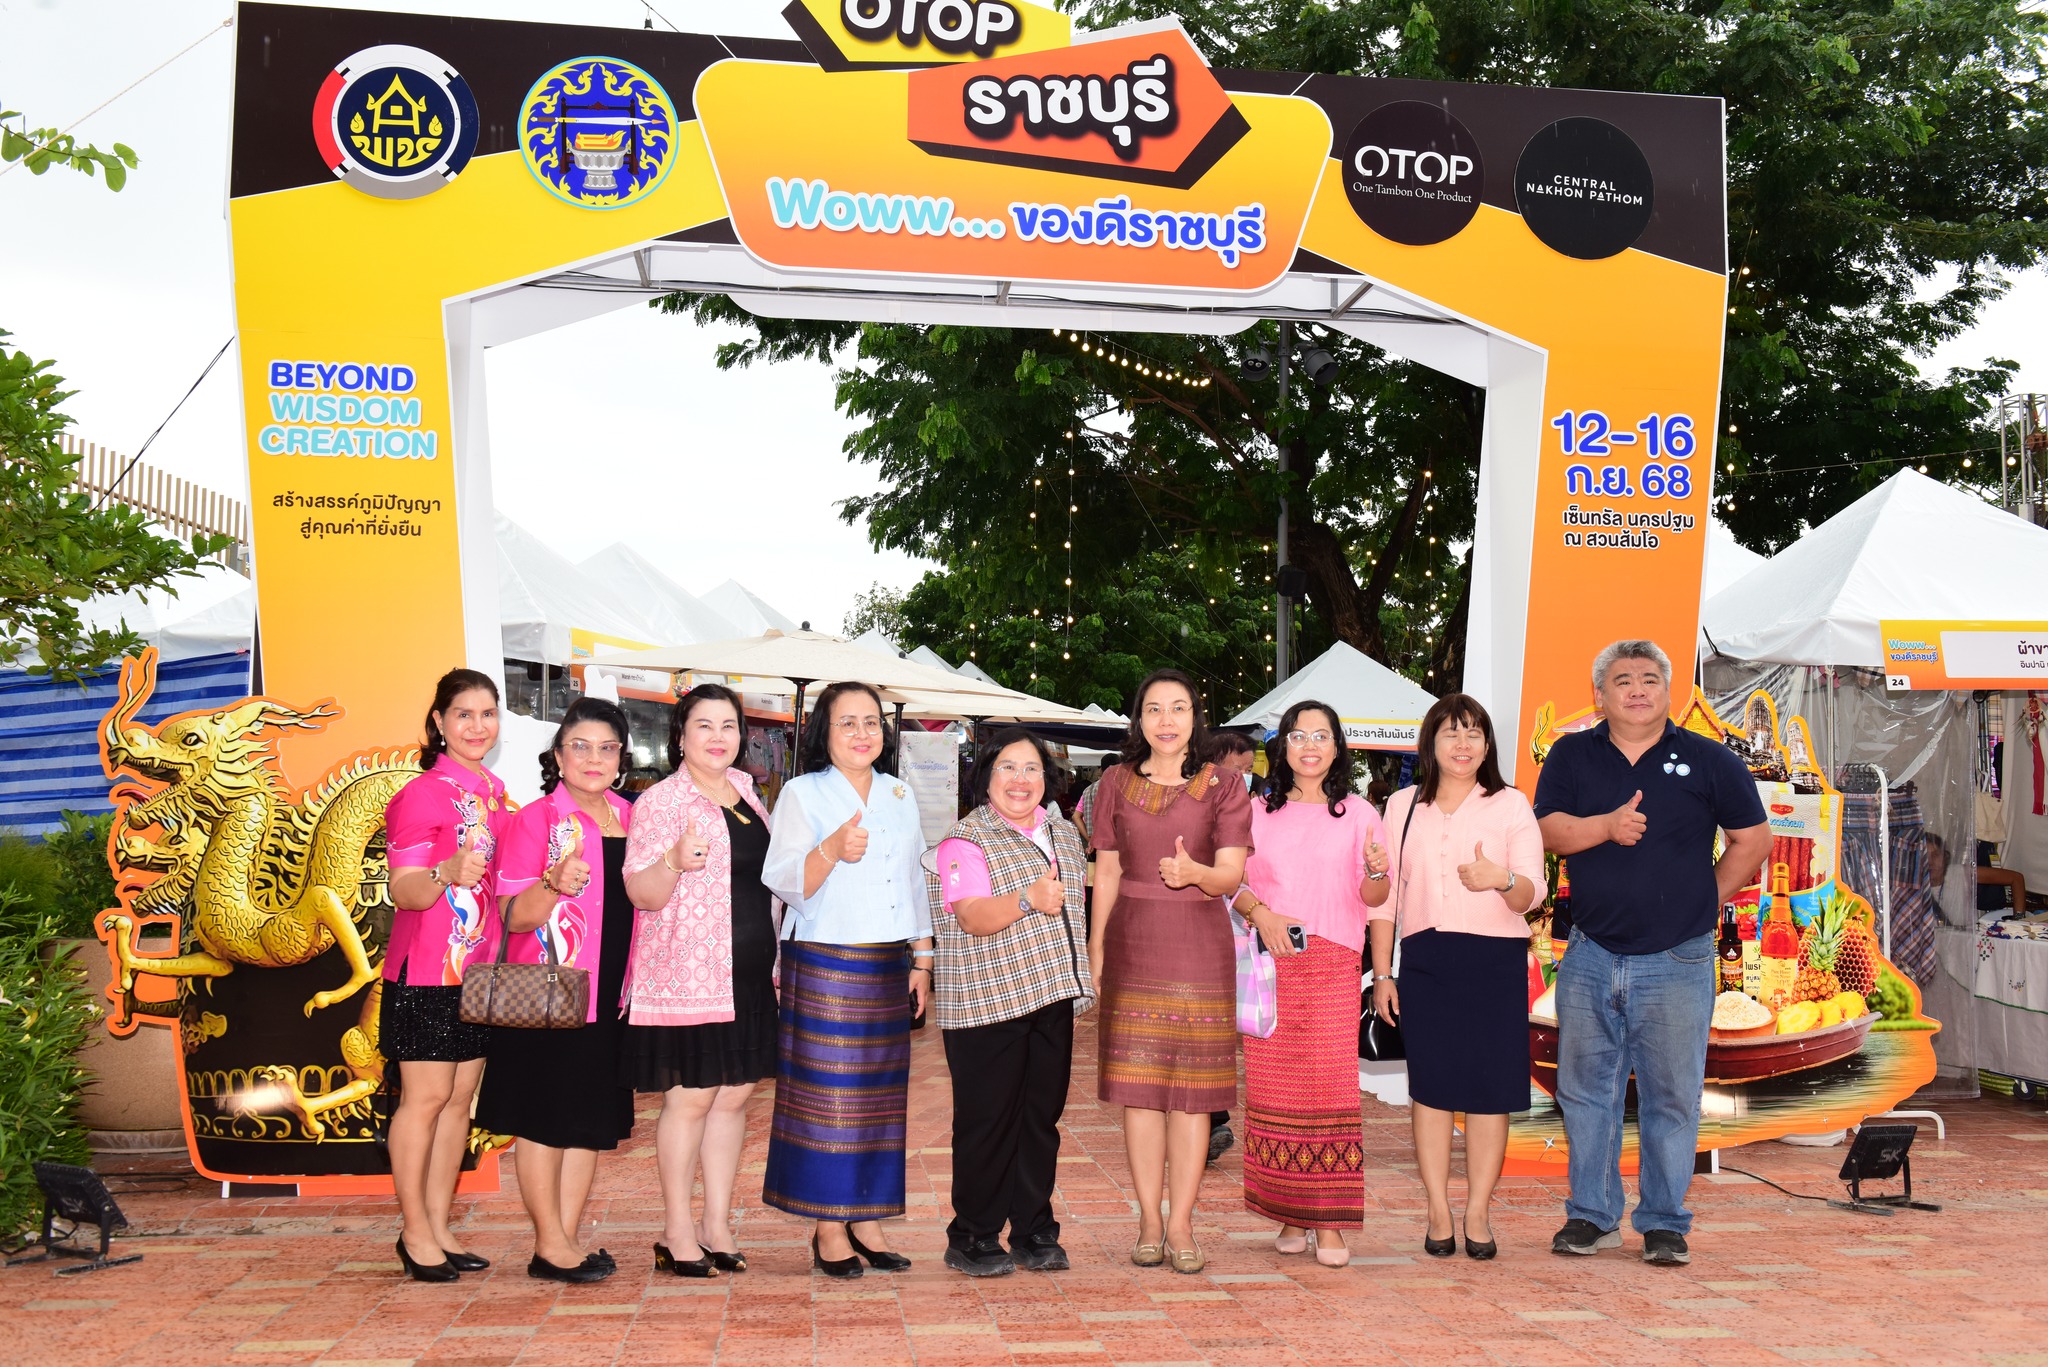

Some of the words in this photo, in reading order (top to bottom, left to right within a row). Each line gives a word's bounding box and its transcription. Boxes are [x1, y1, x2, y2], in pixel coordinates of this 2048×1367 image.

[844, 0, 1015, 46] OTOP
[968, 57, 1172, 147] ราชบุรี
[1354, 144, 1474, 185] OTOP
[1352, 181, 1373, 194] One
[1375, 183, 1413, 197] Tambon
[1415, 186, 1435, 199] One
[1437, 188, 1472, 203] Product
[1526, 182, 1583, 199] NAKHON
[1589, 191, 1643, 206] PATHOM
[1553, 174, 1616, 191] CENTRAL
[1013, 199, 1264, 266] ของดีราชบุรี
[270, 362, 414, 392] BEYOND
[270, 394, 419, 425] WISDOM
[261, 426, 435, 458] CREATION
[1553, 412, 1694, 457] 12-16
[1567, 465, 1633, 496] ก.ย.
[1641, 464, 1691, 498] 68
[272, 490, 441, 514] สร้างสรรค์ภูมิปัญญา
[300, 514, 422, 540] สู่คุณค่าที่ยั่งยืน
[1563, 505, 1623, 527] เซ็นทรัล
[1627, 510, 1694, 533] นครปฐม
[1564, 533, 1582, 546] ณ
[1586, 530, 1659, 549] สวนส้มโอ
[1890, 651, 1938, 664] ของดีราชบุรี
[573, 680, 579, 688] 25
[1344, 727, 1415, 740] ประชาสัมพันธ์
